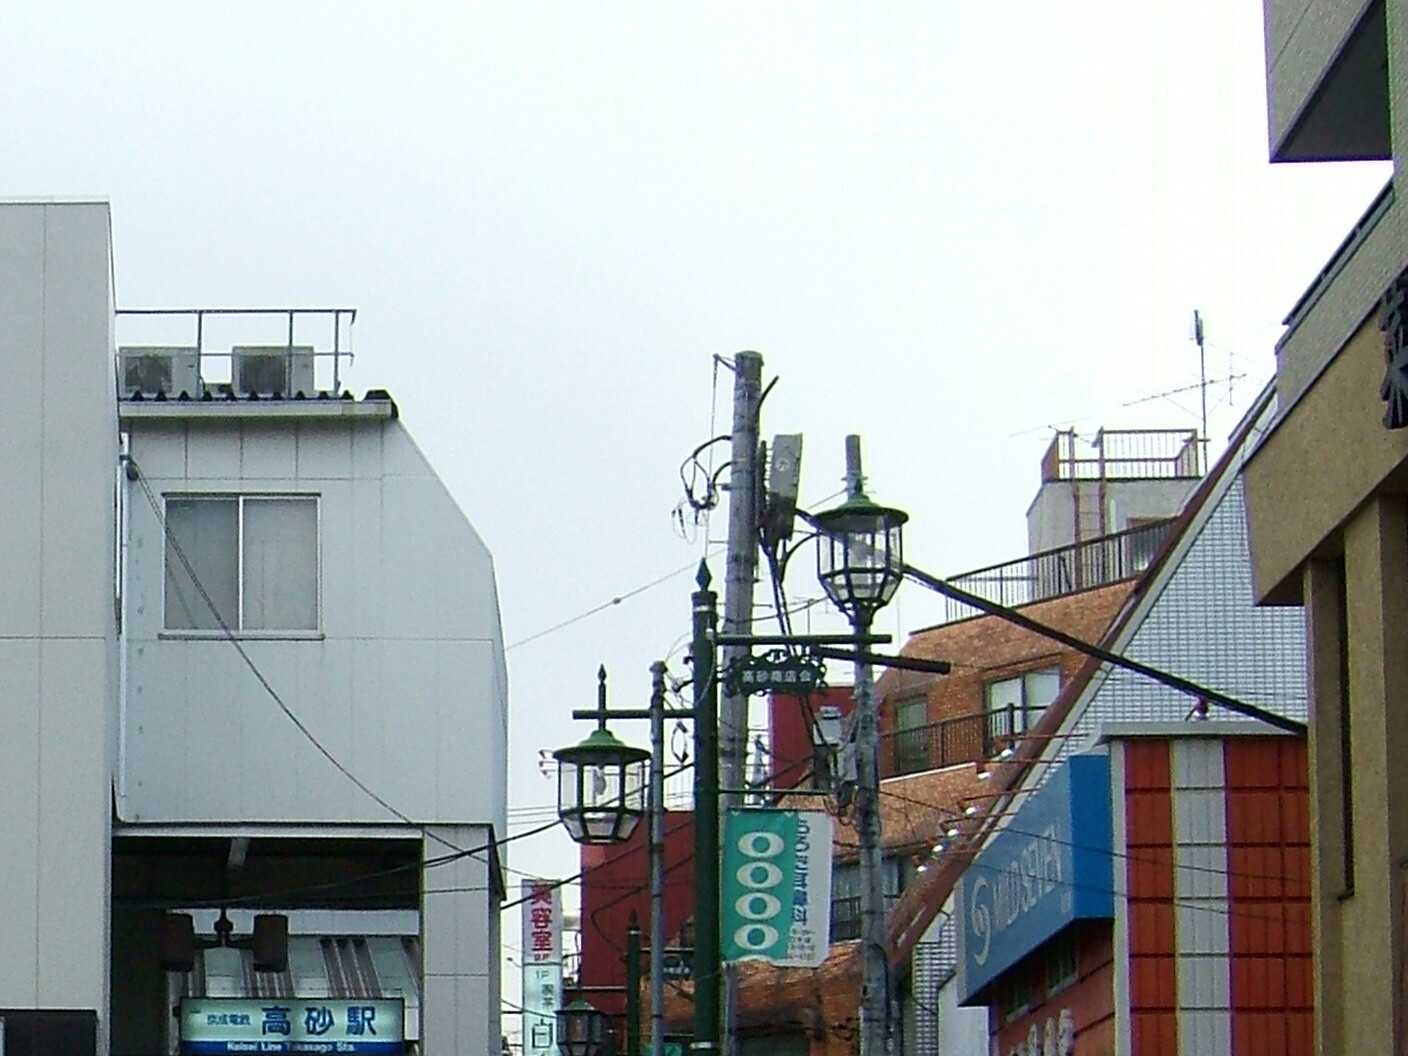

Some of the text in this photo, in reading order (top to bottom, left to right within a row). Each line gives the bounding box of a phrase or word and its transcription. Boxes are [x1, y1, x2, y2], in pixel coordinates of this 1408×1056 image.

[531, 883, 554, 951] 美容室
[261, 1006, 377, 1036] 高砂駅
[227, 1041, 258, 1051] Keisei
[261, 1041, 283, 1051] Line
